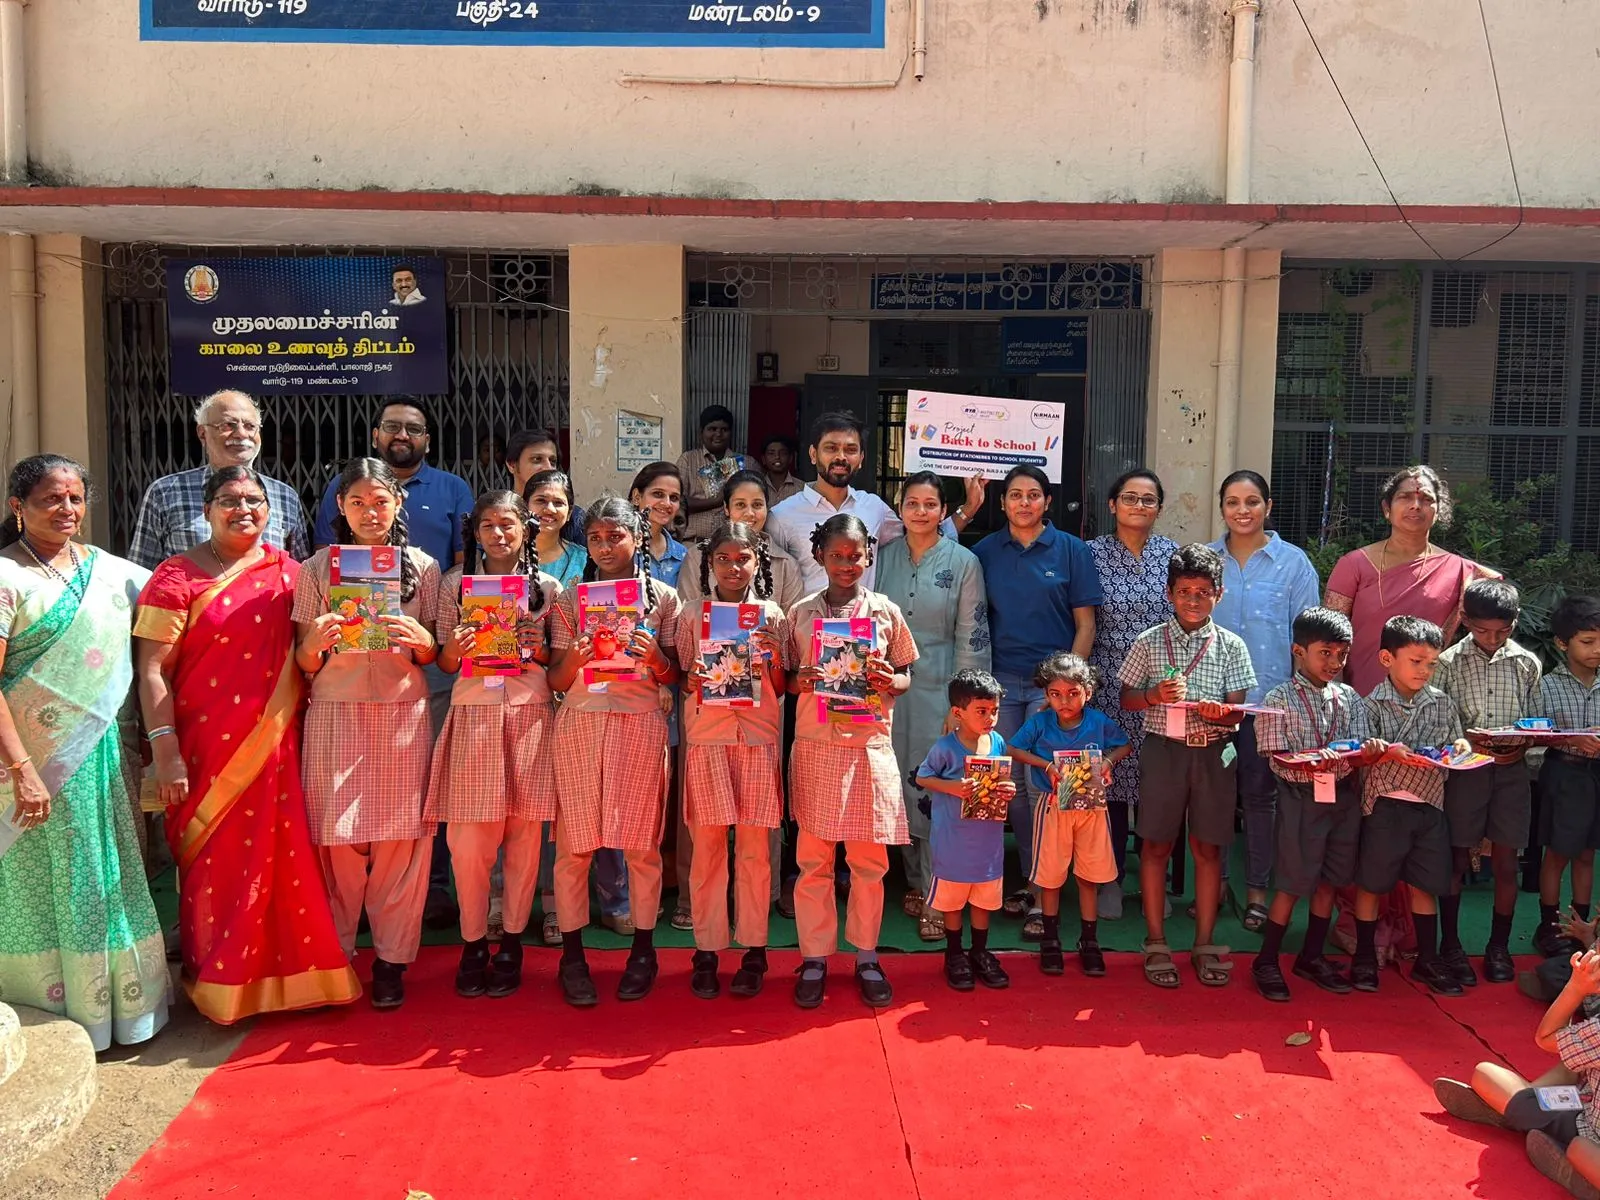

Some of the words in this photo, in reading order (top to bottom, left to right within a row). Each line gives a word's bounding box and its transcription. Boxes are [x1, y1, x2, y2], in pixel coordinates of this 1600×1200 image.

[212, 308, 399, 335] முதலமைச்சரின்
[198, 341, 263, 356] காலை
[267, 337, 349, 359] உணவுத்
[352, 336, 415, 358] திட்டம்
[226, 363, 268, 372] சென்னை
[341, 362, 373, 372] பாலாஜி
[374, 362, 393, 373] நகர்
[944, 421, 976, 440] Project
[940, 433, 973, 447] Back
[977, 436, 990, 448] to
[993, 437, 1037, 451] School
[922, 449, 952, 458] DISTRIBUTION
[960, 452, 991, 461] STATIONERIES
